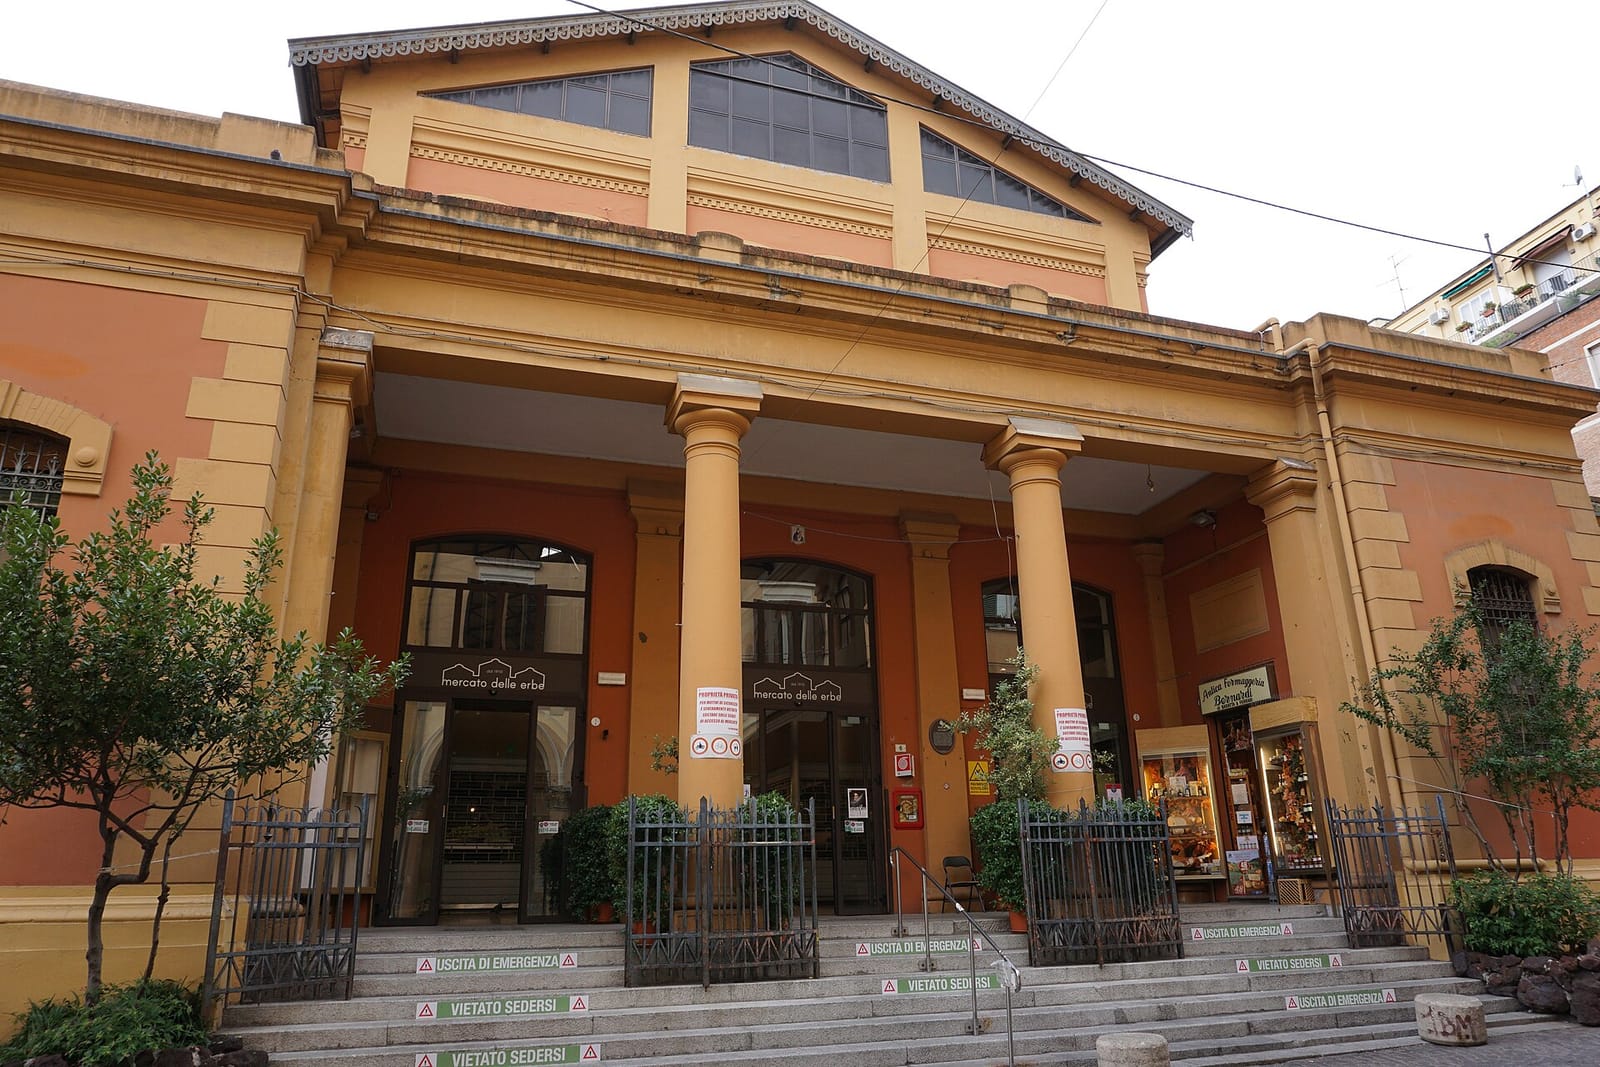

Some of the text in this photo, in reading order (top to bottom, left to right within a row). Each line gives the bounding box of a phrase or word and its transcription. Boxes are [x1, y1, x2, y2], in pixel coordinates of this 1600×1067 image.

[441, 677, 545, 690] mercato delle erbe
[753, 690, 842, 701] mercato delle erbe
[1204, 926, 1282, 939] USCITA DI EMERGENZA
[871, 941, 901, 954] USCITA
[904, 941, 913, 953] DI
[437, 955, 559, 972] USCITA DI EMERGENZA
[1257, 957, 1322, 971] VIETATO SEDERSI
[908, 978, 948, 991] VIETATO
[451, 998, 556, 1016] VIETATO SEDERSI
[1299, 992, 1384, 1009] USCITA DI EMERGENZA
[452, 1047, 566, 1067] VIETATO SEDERSI
